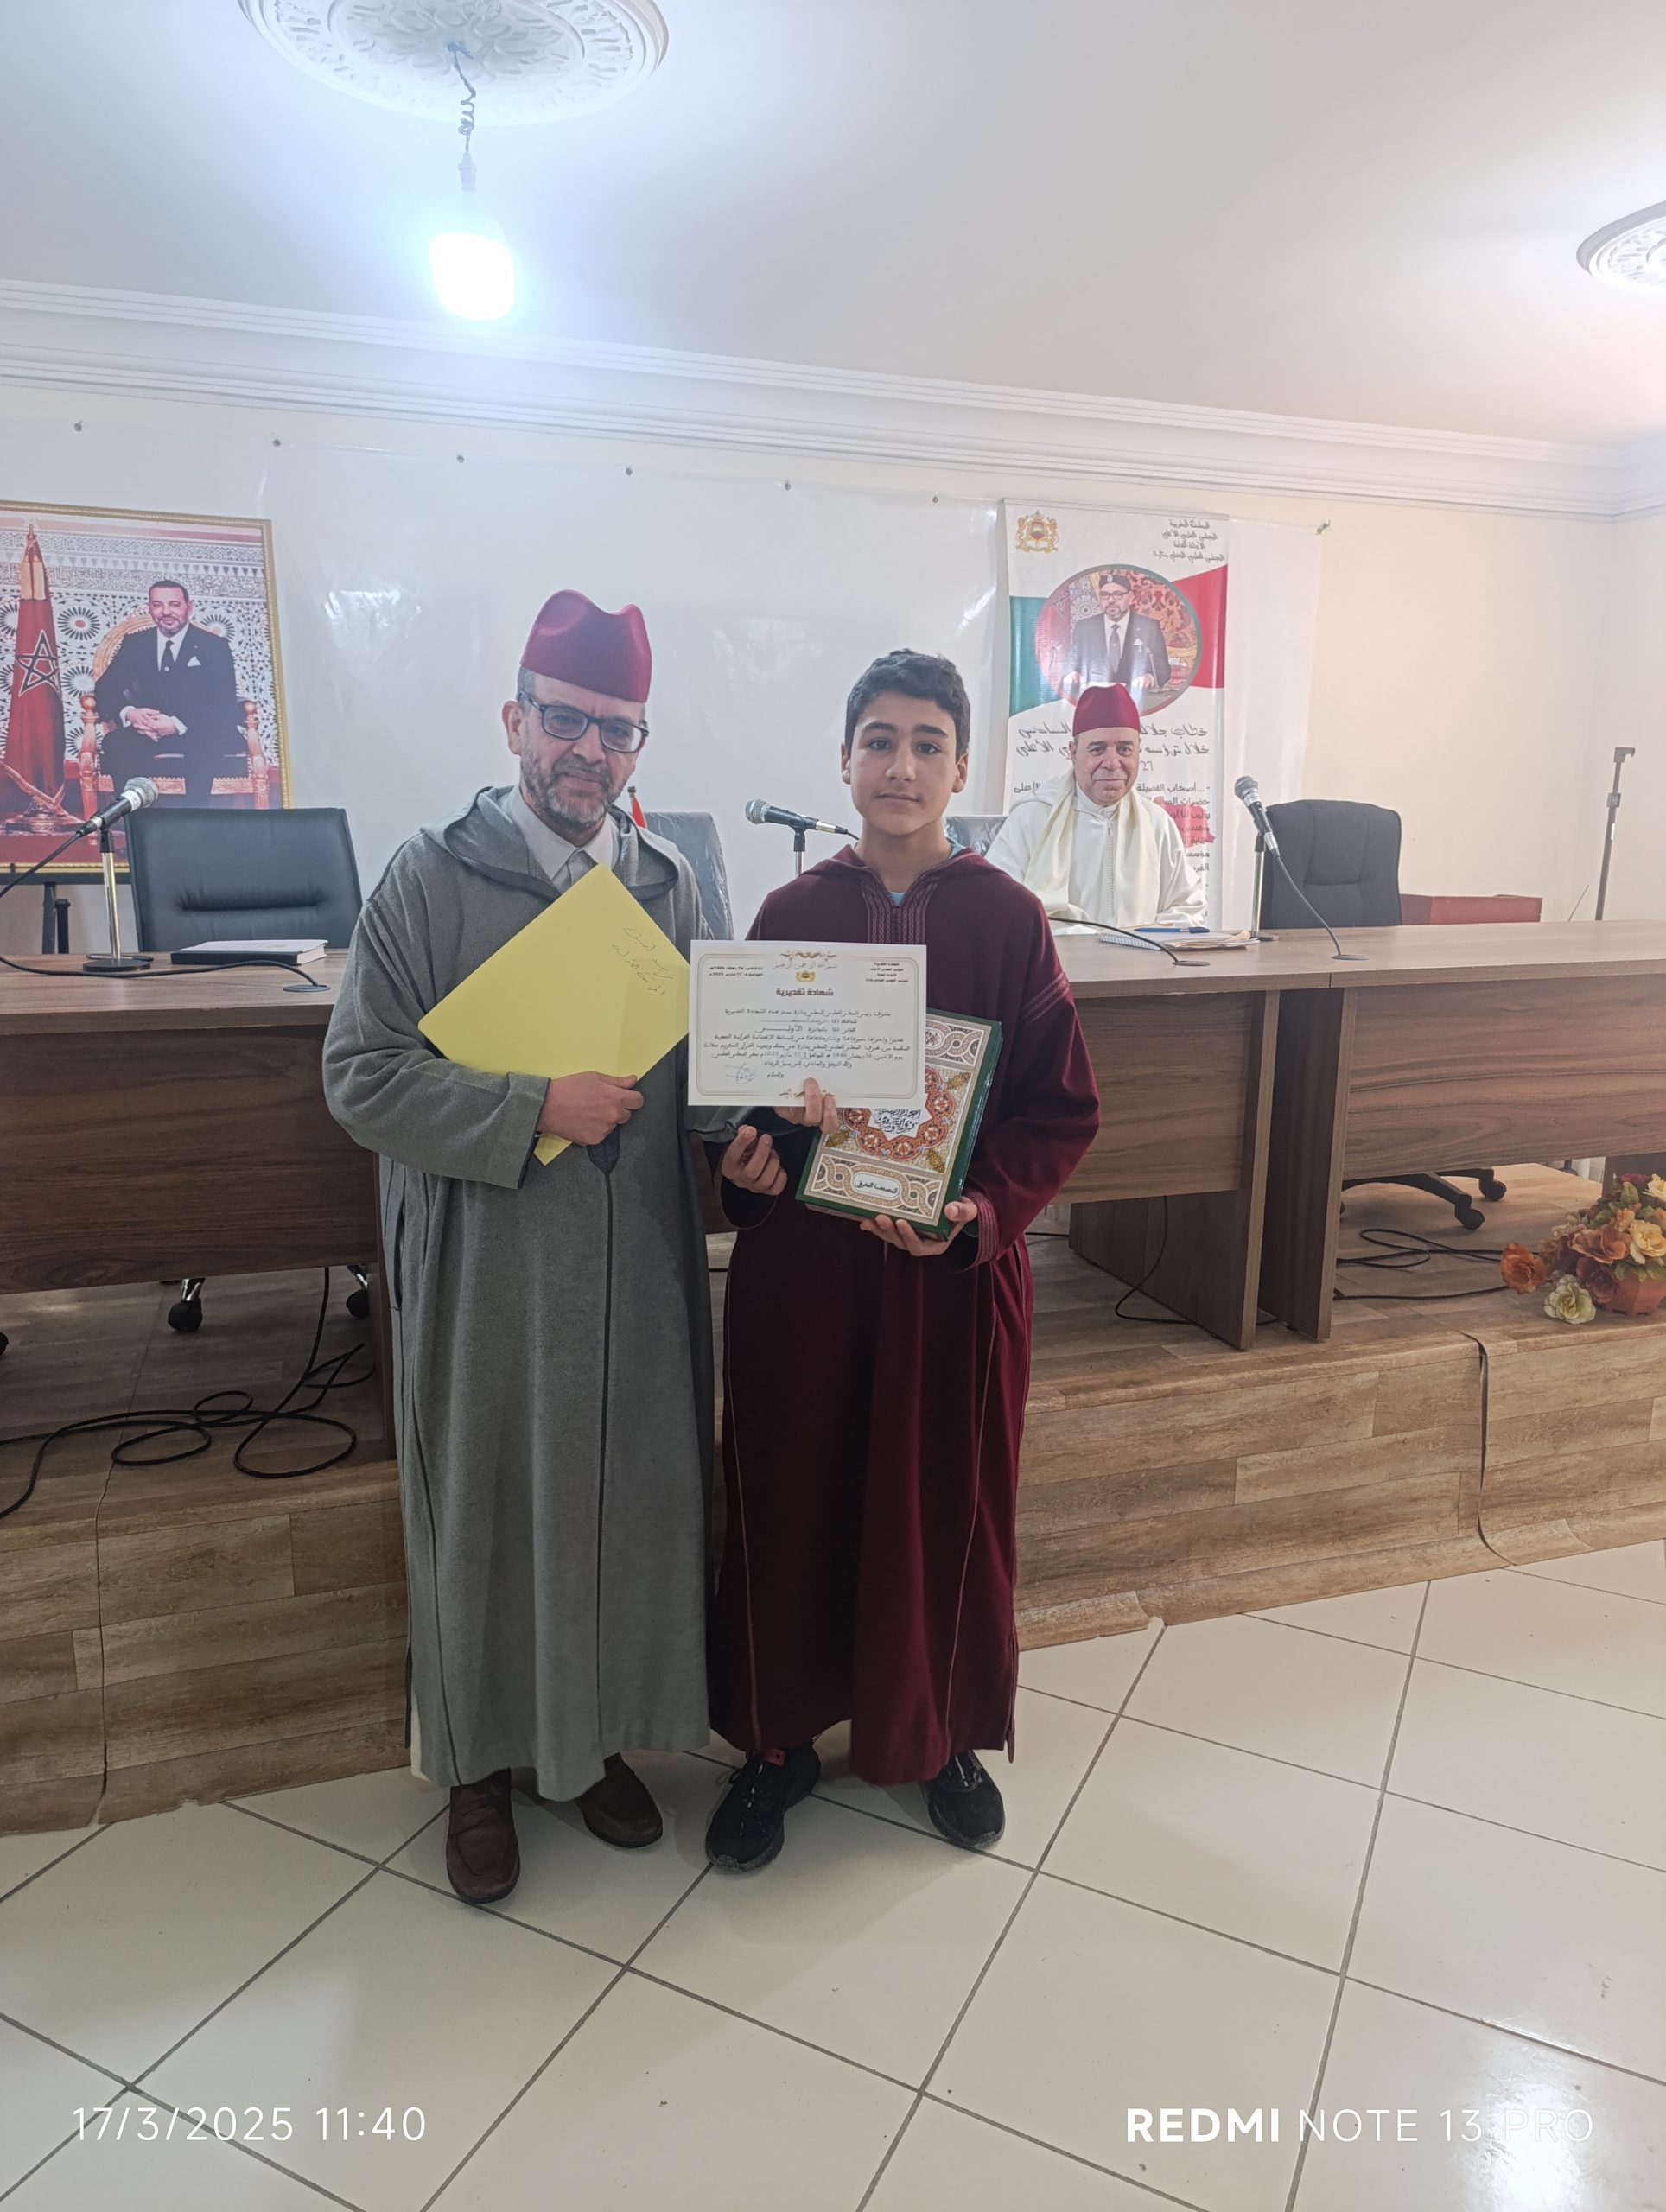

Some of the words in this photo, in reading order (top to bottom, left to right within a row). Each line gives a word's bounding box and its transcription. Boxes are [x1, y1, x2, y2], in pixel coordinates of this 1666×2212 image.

[1180, 530, 1197, 541] العلمي
[1198, 531, 1218, 542] المجلس
[1170, 723, 1208, 739] خطاب
[1184, 742, 1210, 755] خلال
[776, 988, 805, 997] تقديرية
[807, 988, 834, 996] شهادة
